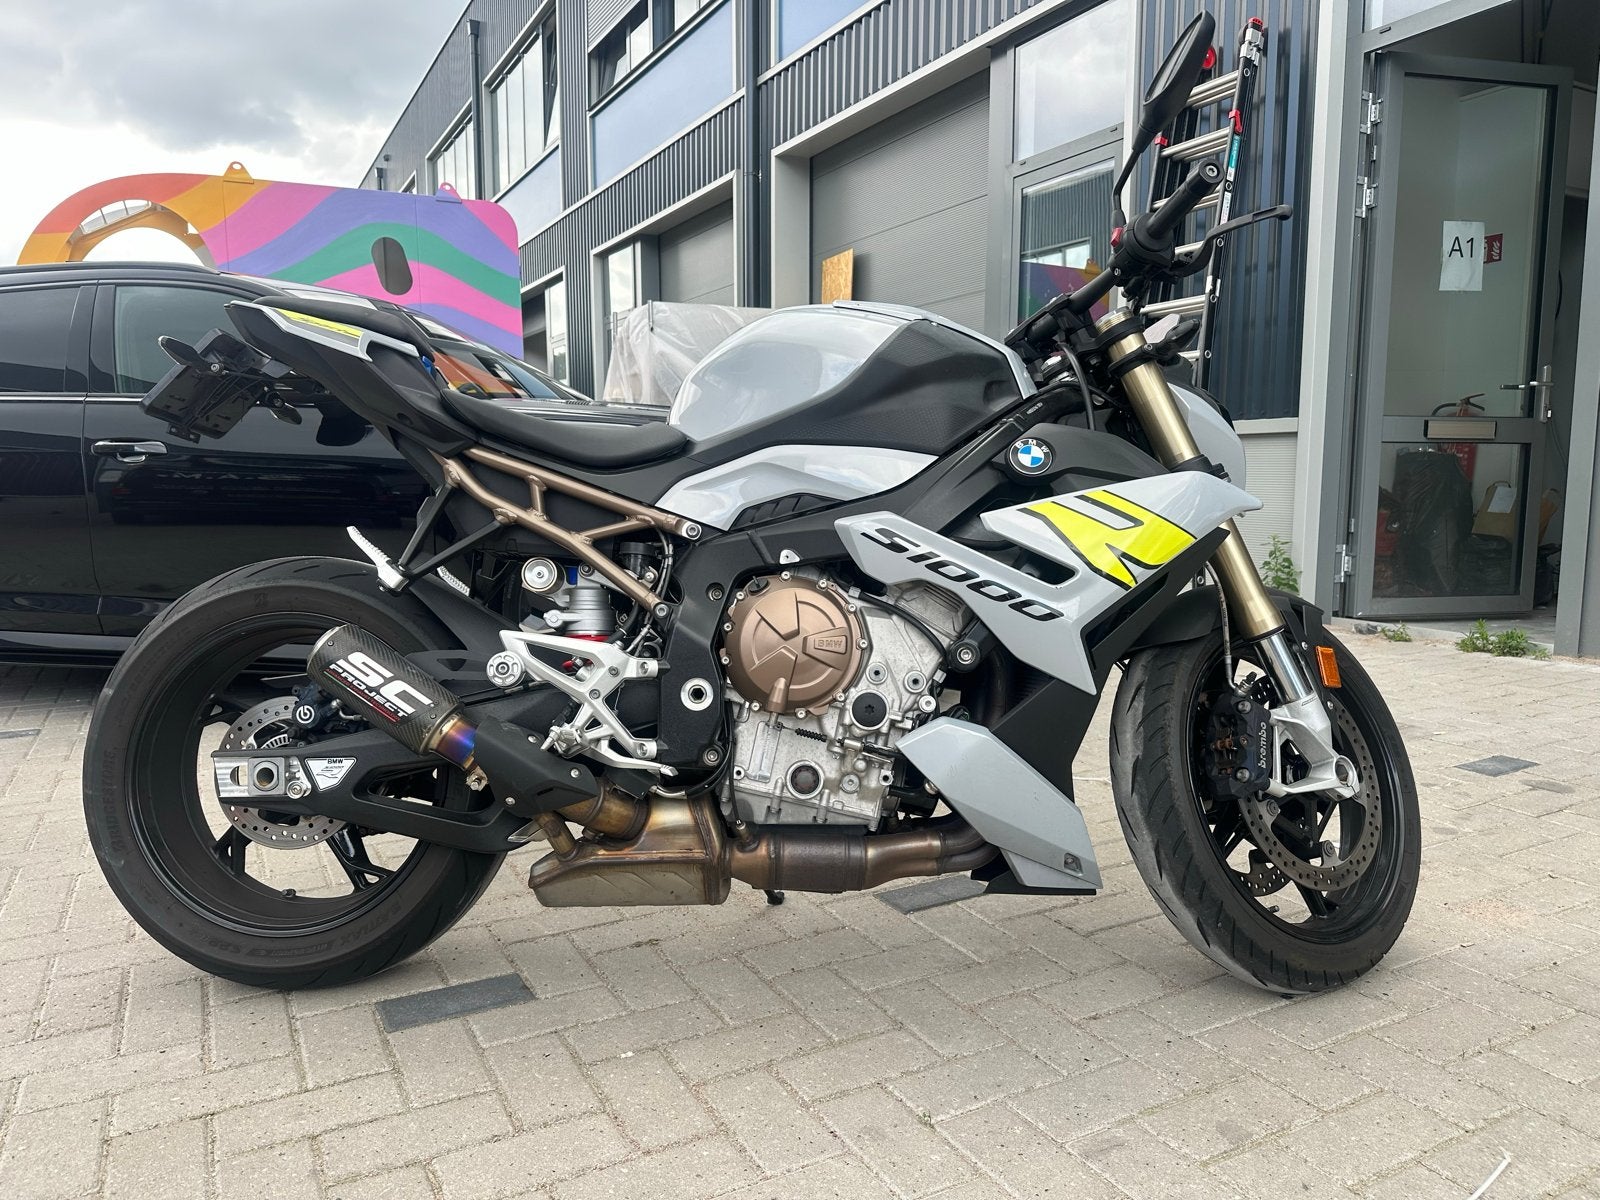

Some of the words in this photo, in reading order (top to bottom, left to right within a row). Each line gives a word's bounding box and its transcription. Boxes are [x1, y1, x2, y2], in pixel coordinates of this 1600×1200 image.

[1448, 236, 1475, 258] A1
[1015, 438, 1050, 454] BMW
[860, 527, 1064, 622] S1000
[817, 638, 844, 649] BMW
[328, 663, 409, 718] PROJECT
[335, 651, 433, 715] SC
[1258, 721, 1267, 769] brembo
